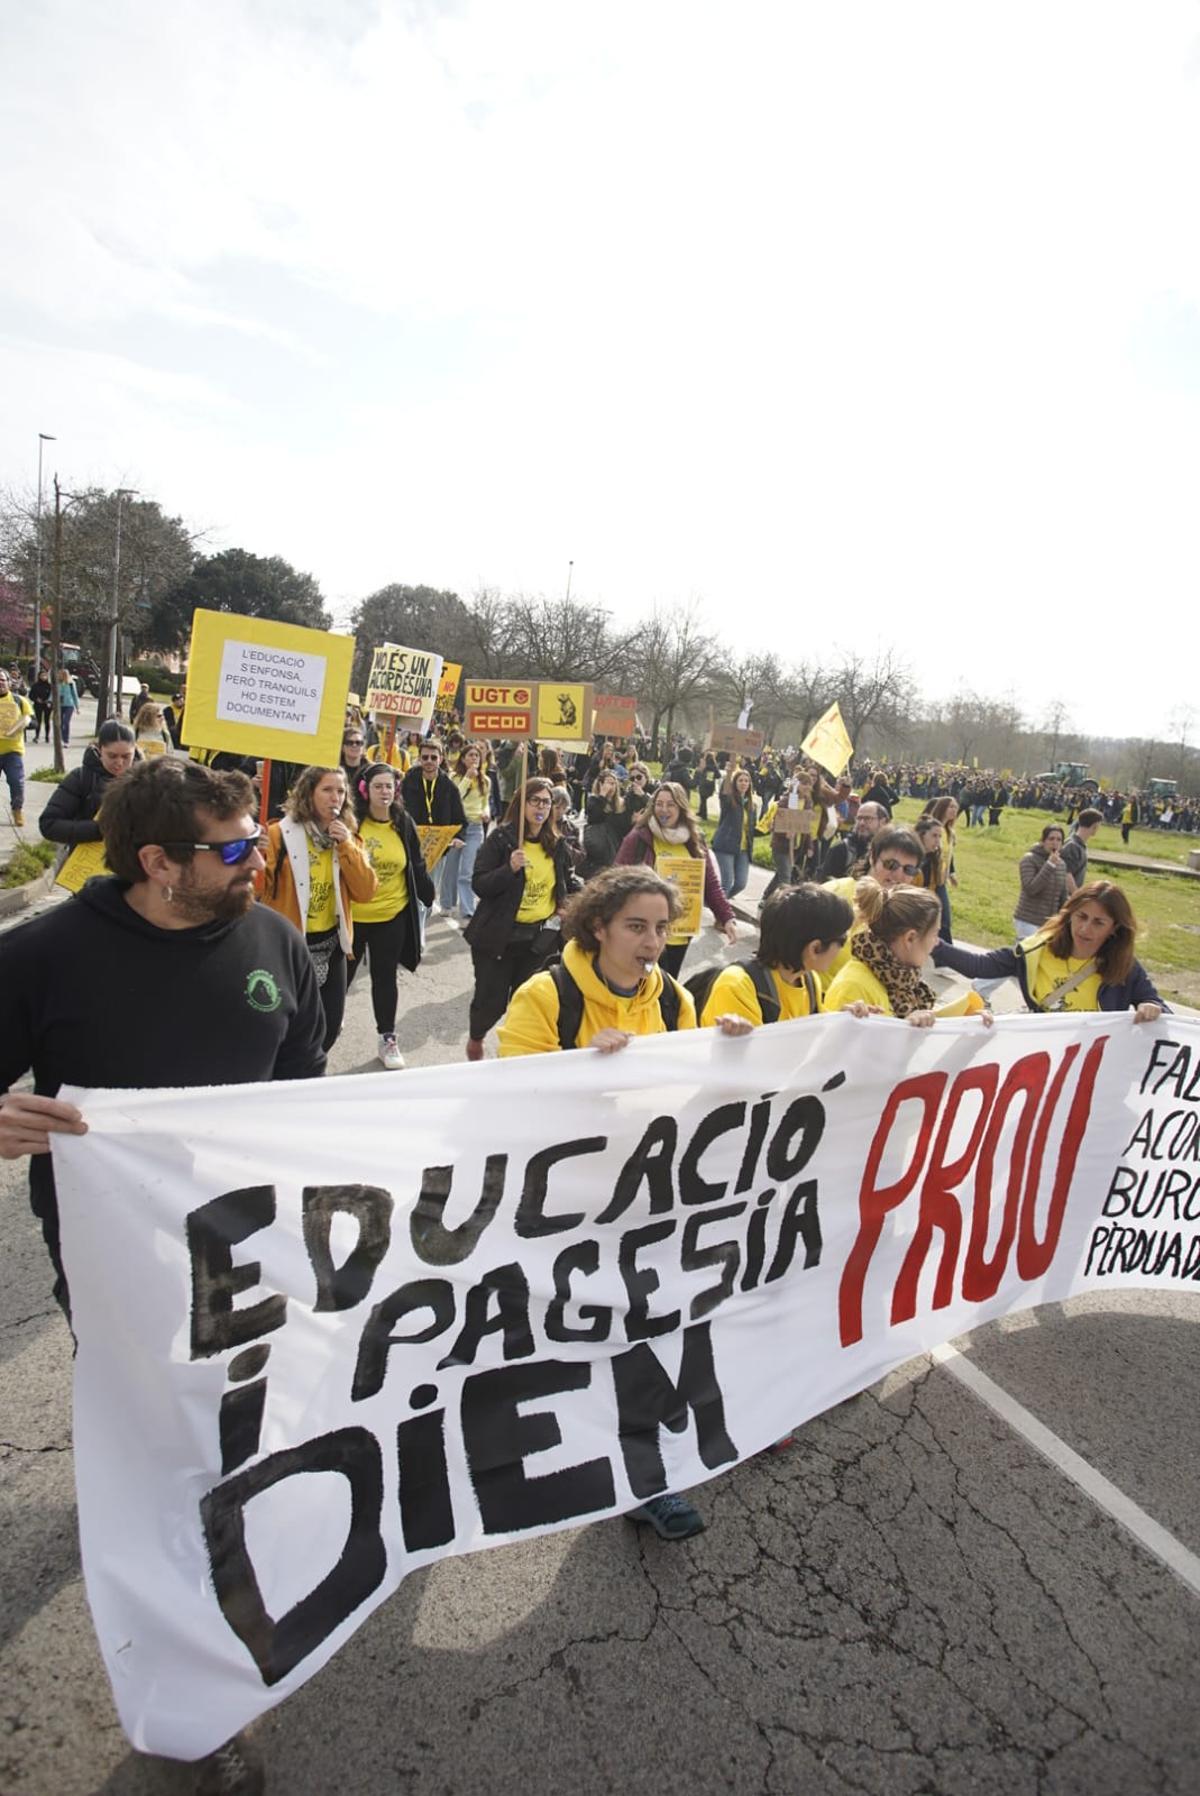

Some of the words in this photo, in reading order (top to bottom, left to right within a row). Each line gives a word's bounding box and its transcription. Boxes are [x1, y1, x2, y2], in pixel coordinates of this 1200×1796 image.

[374, 651, 388, 670] NO
[411, 655, 430, 678] UN
[241, 690, 258, 702] HO
[259, 693, 296, 708] ESTEM
[258, 679, 317, 699] TRANQUILS
[471, 687, 511, 704] UGT
[226, 701, 306, 723] DOCUMENTANT
[474, 715, 526, 729] CCOO
[838, 1035, 1110, 1348] PROU
